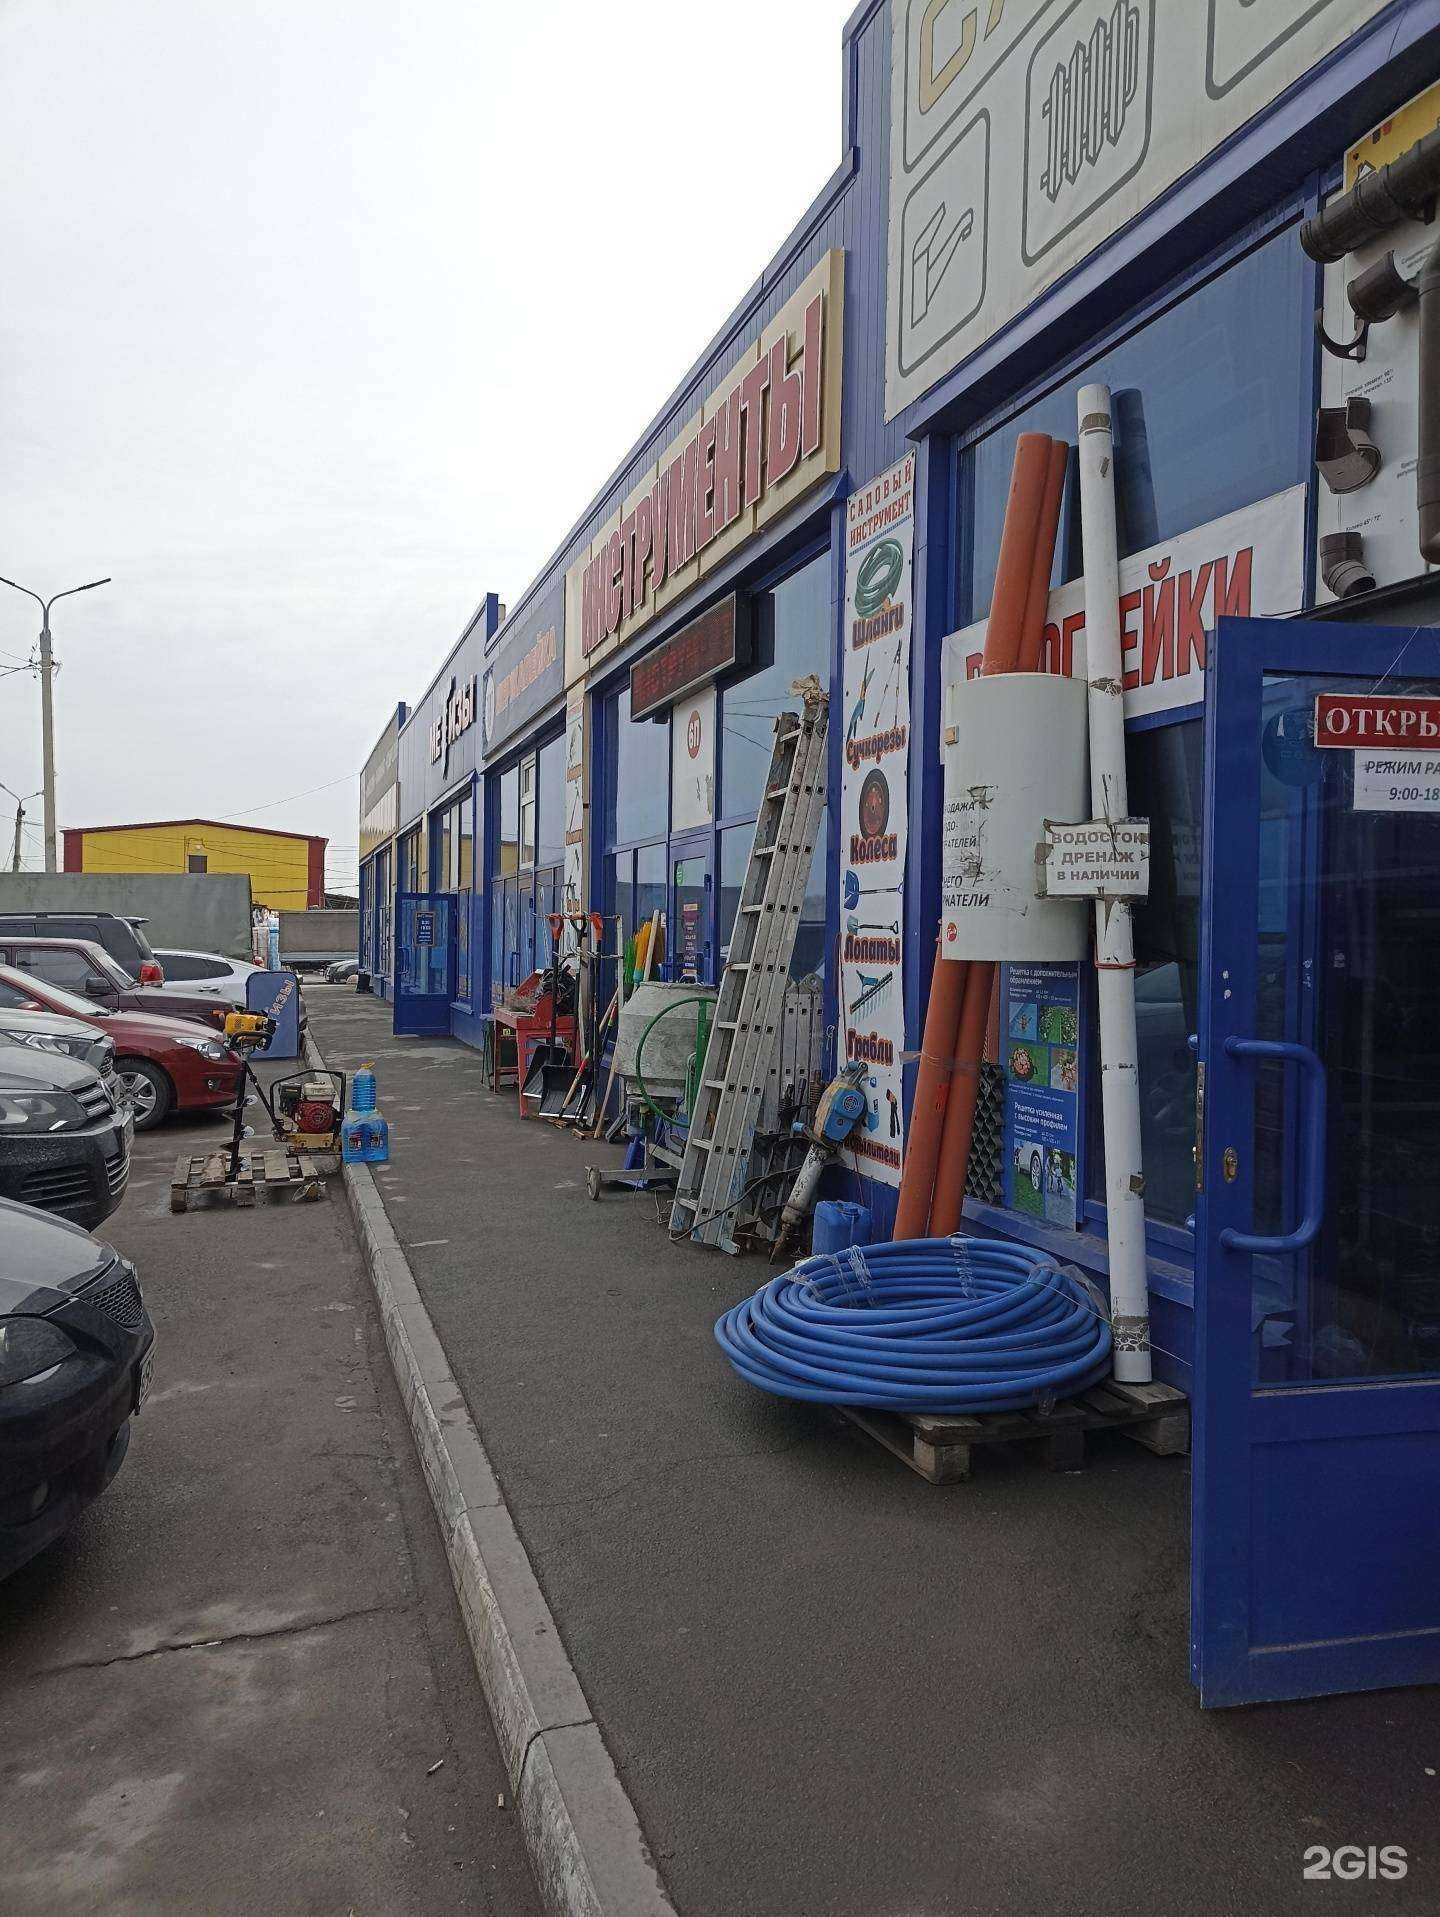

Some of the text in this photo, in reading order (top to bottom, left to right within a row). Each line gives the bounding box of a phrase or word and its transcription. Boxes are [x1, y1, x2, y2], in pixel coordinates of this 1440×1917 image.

[582, 289, 823, 658] ИНСТРУМЕНТЫ
[850, 461, 912, 522] САДОВЫЙ
[850, 491, 911, 548] ИНСТРУМЕНТ
[852, 602, 905, 651] Шланги
[846, 725, 907, 770] Сучкорезы
[1366, 760, 1421, 774] РЕЖИМ
[850, 833, 898, 864] Колеса
[1062, 852, 1134, 865] ДРЕНАЖ
[1071, 870, 1139, 880] НАЛИЧИИ
[844, 933, 901, 965] Лопаты
[847, 1027, 894, 1067] Грабли
